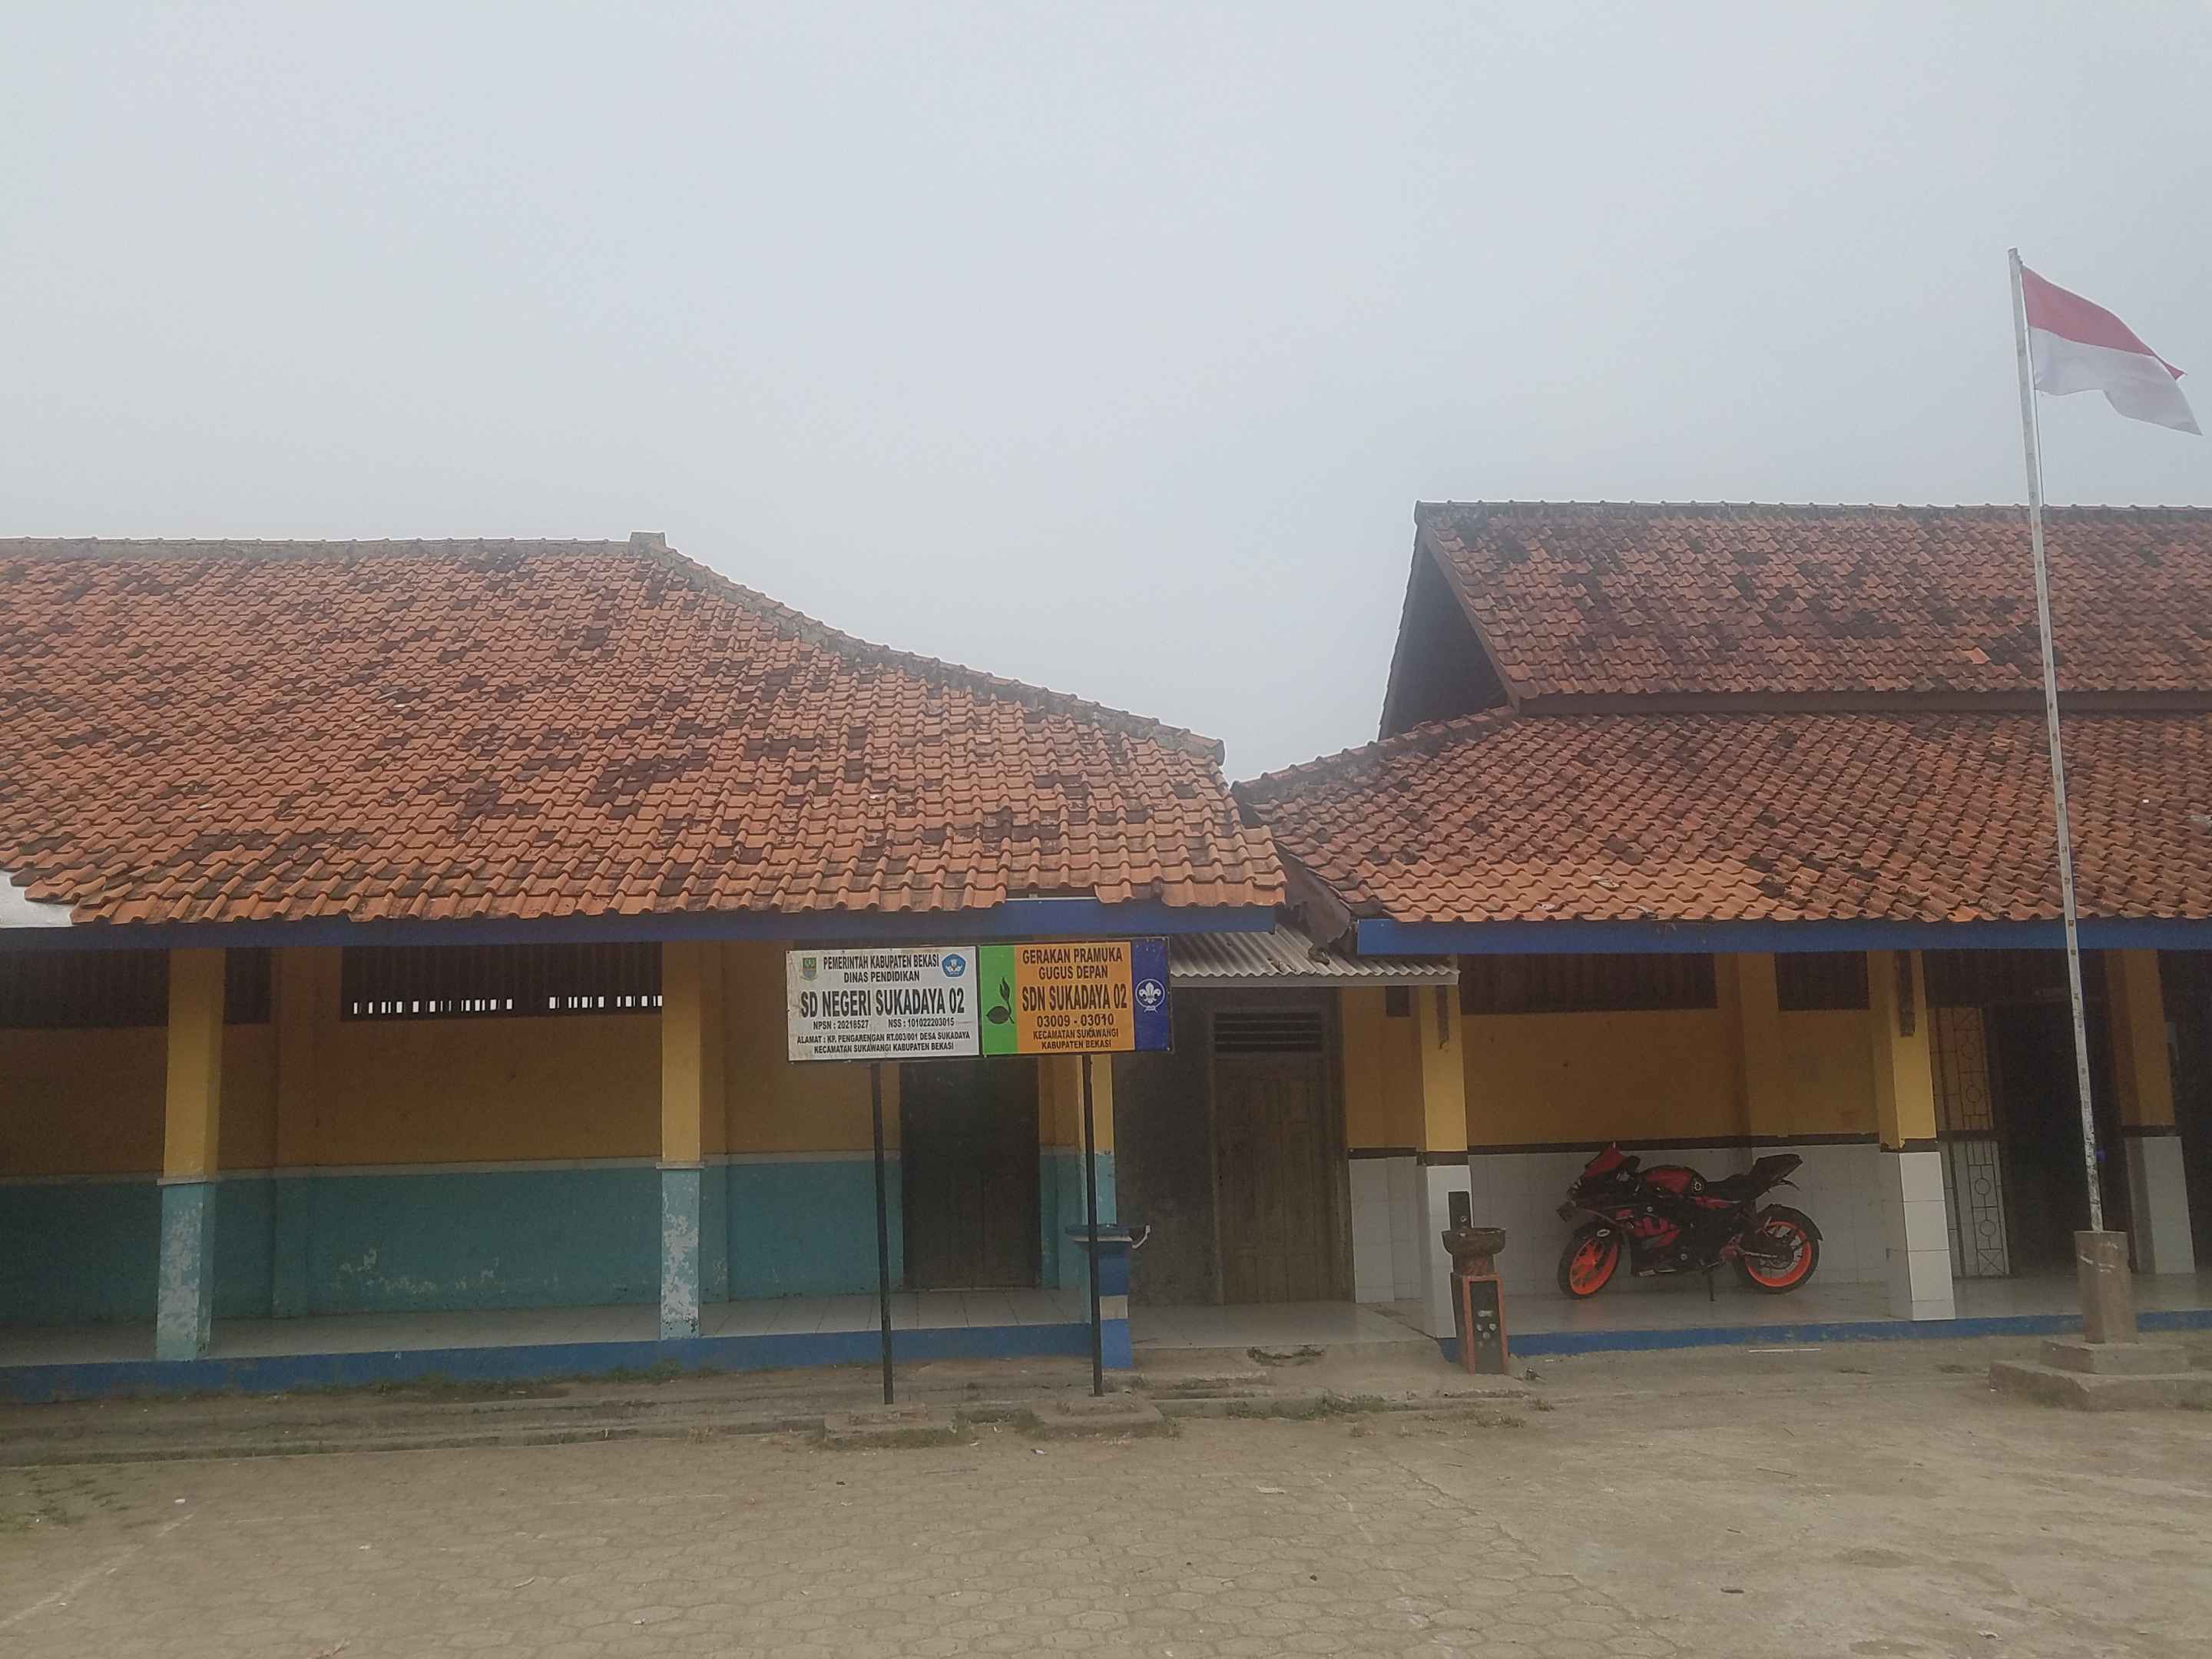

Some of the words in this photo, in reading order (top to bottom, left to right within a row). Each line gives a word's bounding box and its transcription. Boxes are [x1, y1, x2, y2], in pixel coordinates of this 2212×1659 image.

[823, 955, 868, 970] PEMERINTAH
[870, 955, 912, 969] KABUPATEN
[914, 954, 939, 967] BEKASI
[1022, 949, 1071, 964] GERAKAN
[1074, 948, 1122, 962] PRAMUKA
[844, 972, 868, 983] DINAS
[871, 971, 919, 982] PENDIDIKAN
[1039, 966, 1073, 979] GUGUS
[1077, 965, 1108, 979] DEPAN
[801, 992, 817, 1018] SD
[823, 989, 871, 1017] NEGERI
[876, 988, 945, 1015] SUKADAYA
[949, 988, 965, 1014] 02
[1022, 986, 1045, 1012] SDN
[1050, 984, 1111, 1011] SUKADAYA
[1114, 983, 1128, 1008] 02
[813, 1021, 831, 1029] NPSN
[888, 1019, 902, 1028] NSS
[908, 1018, 954, 1027] 101022203015
[1037, 1015, 1070, 1027] 03009
[1081, 1014, 1114, 1026] 03010
[797, 1036, 822, 1045] ALAMAT
[839, 1034, 885, 1042] PENGARENGAN
[937, 1031, 970, 1040] SUKADAYA
[1033, 1030, 1075, 1039] KECAMATAN
[1077, 1028, 1118, 1038] SUKAWANGI
[814, 1044, 852, 1054] KECAMATAN
[854, 1043, 891, 1052] SUKAWANGI
[892, 1043, 929, 1051] KABUPATEN
[932, 1042, 953, 1051] BEKASI
[1041, 1041, 1083, 1050] KABUPATEN
[1086, 1040, 1111, 1048] BEKASI
